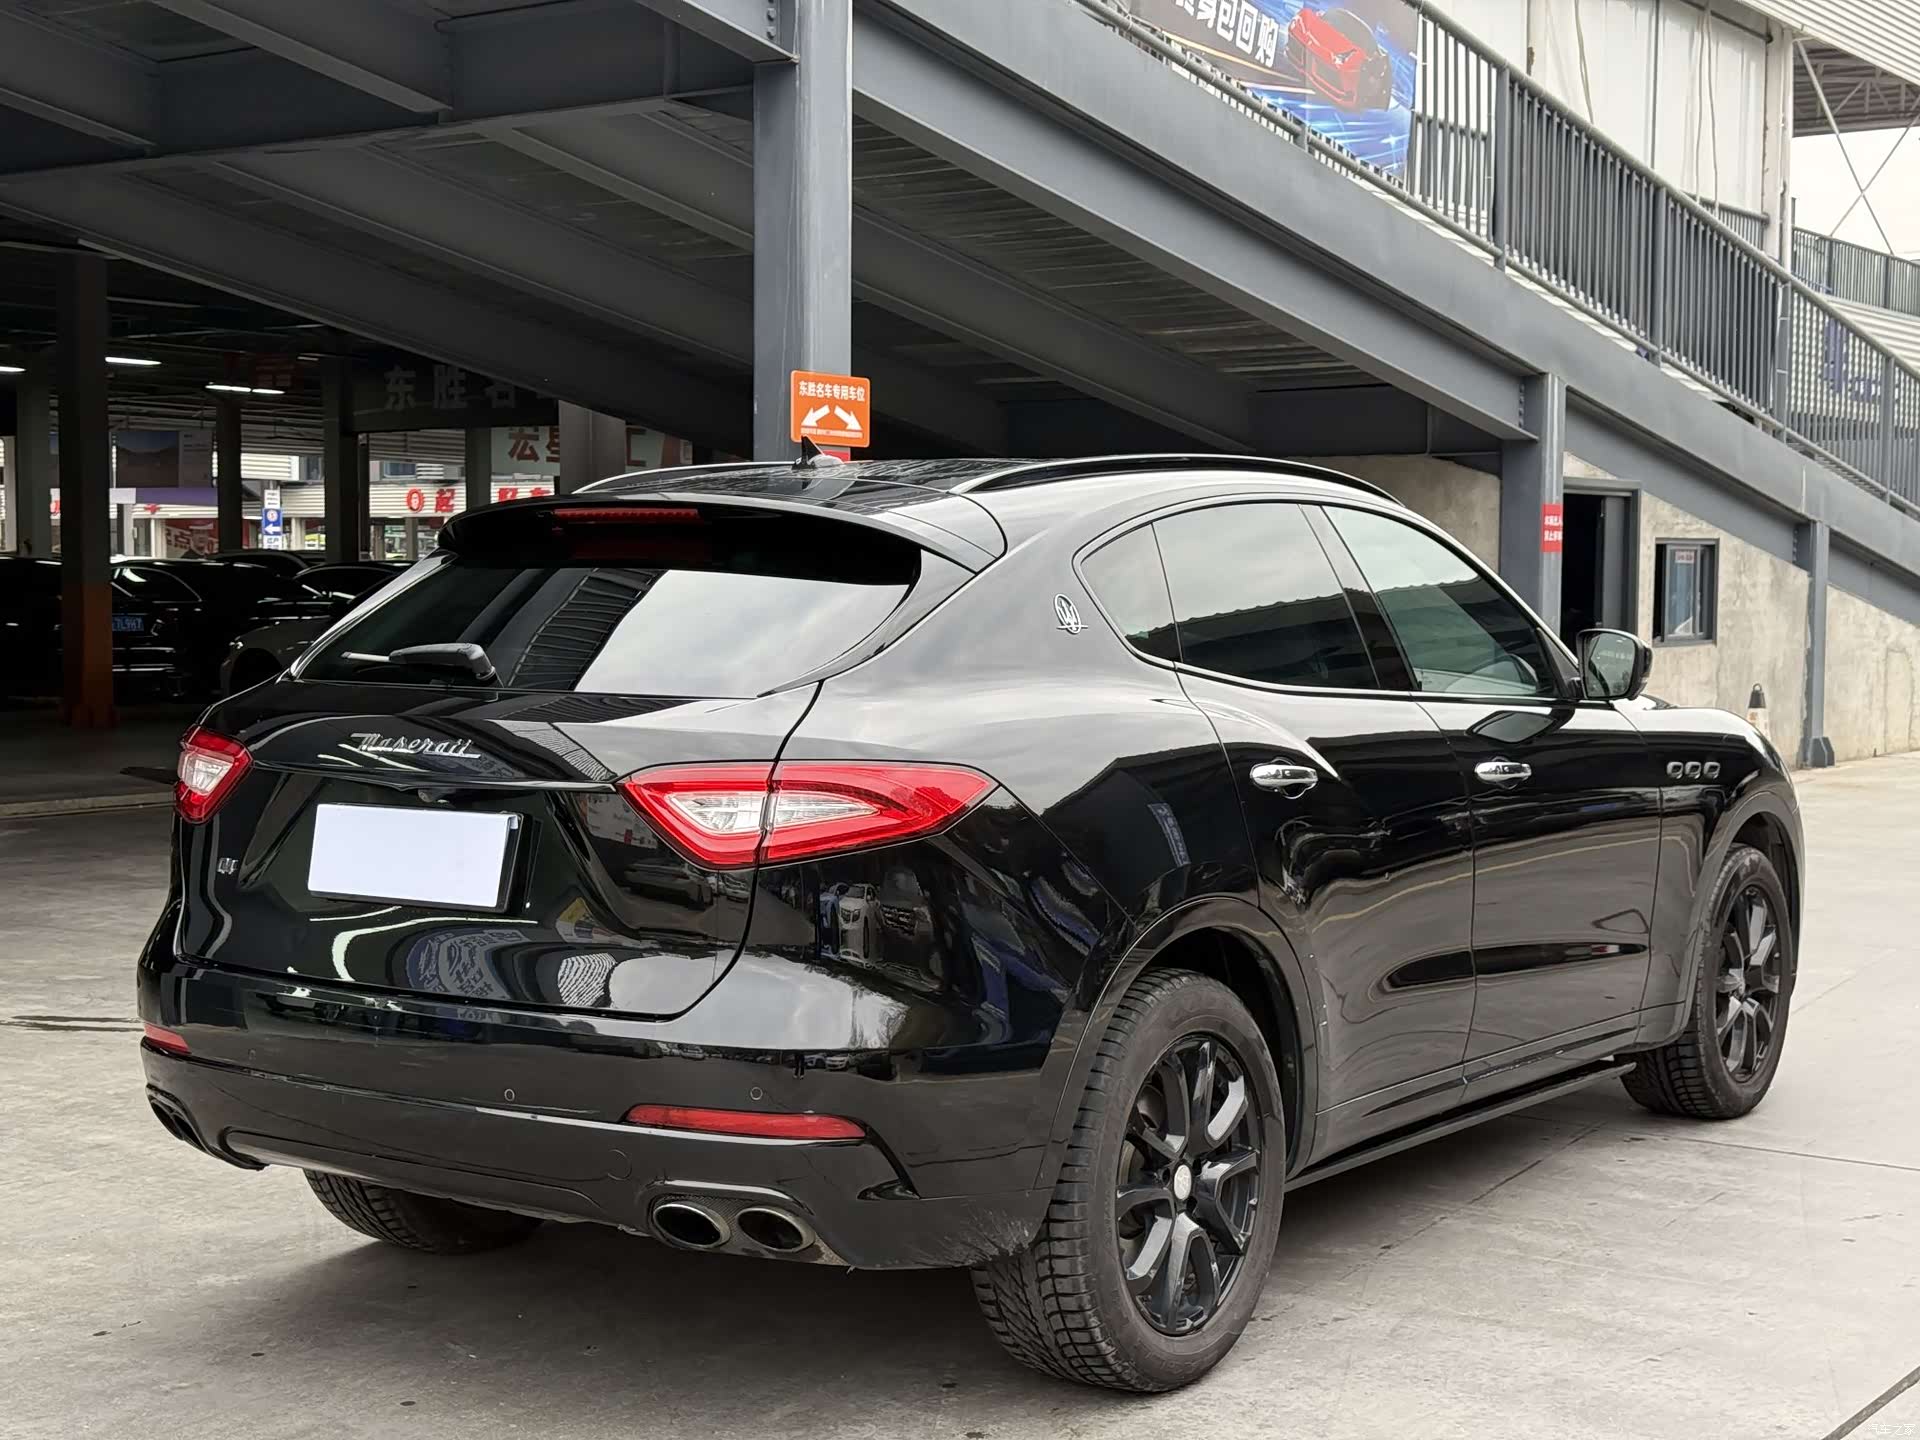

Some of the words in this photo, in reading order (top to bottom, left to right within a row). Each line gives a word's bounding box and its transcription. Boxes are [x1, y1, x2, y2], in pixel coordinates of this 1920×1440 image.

[799, 380, 866, 402] 东胜名车专用车位
